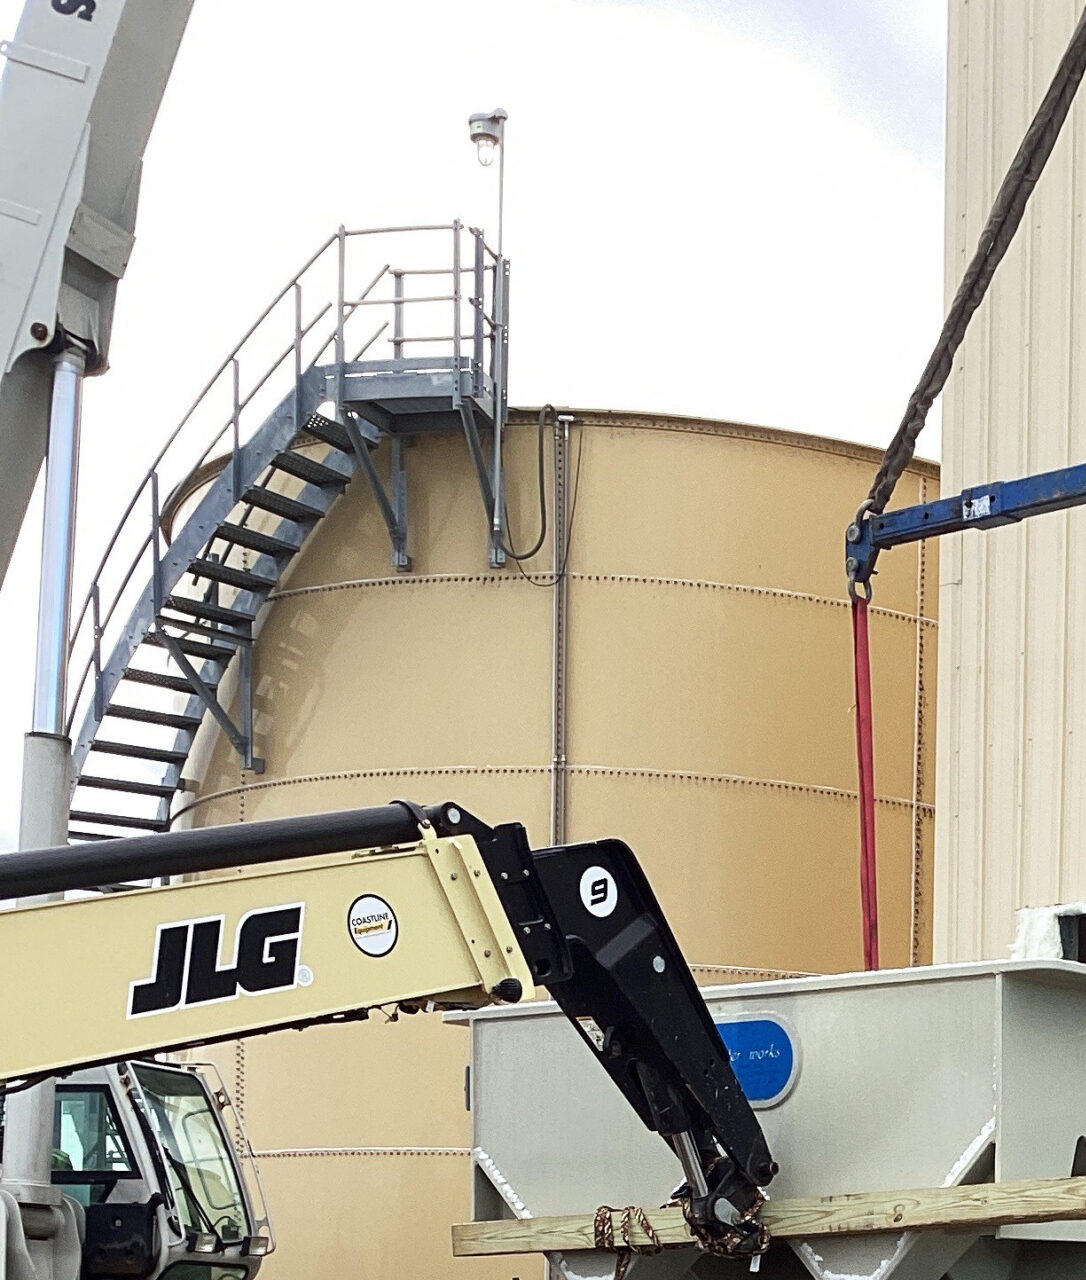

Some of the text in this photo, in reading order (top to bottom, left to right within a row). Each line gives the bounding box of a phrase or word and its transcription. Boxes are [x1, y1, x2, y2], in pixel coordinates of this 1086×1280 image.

[591, 877, 608, 906] 9
[351, 912, 389, 926] COASTLINE
[129, 905, 303, 1017] JLG
[749, 1043, 781, 1060] works
